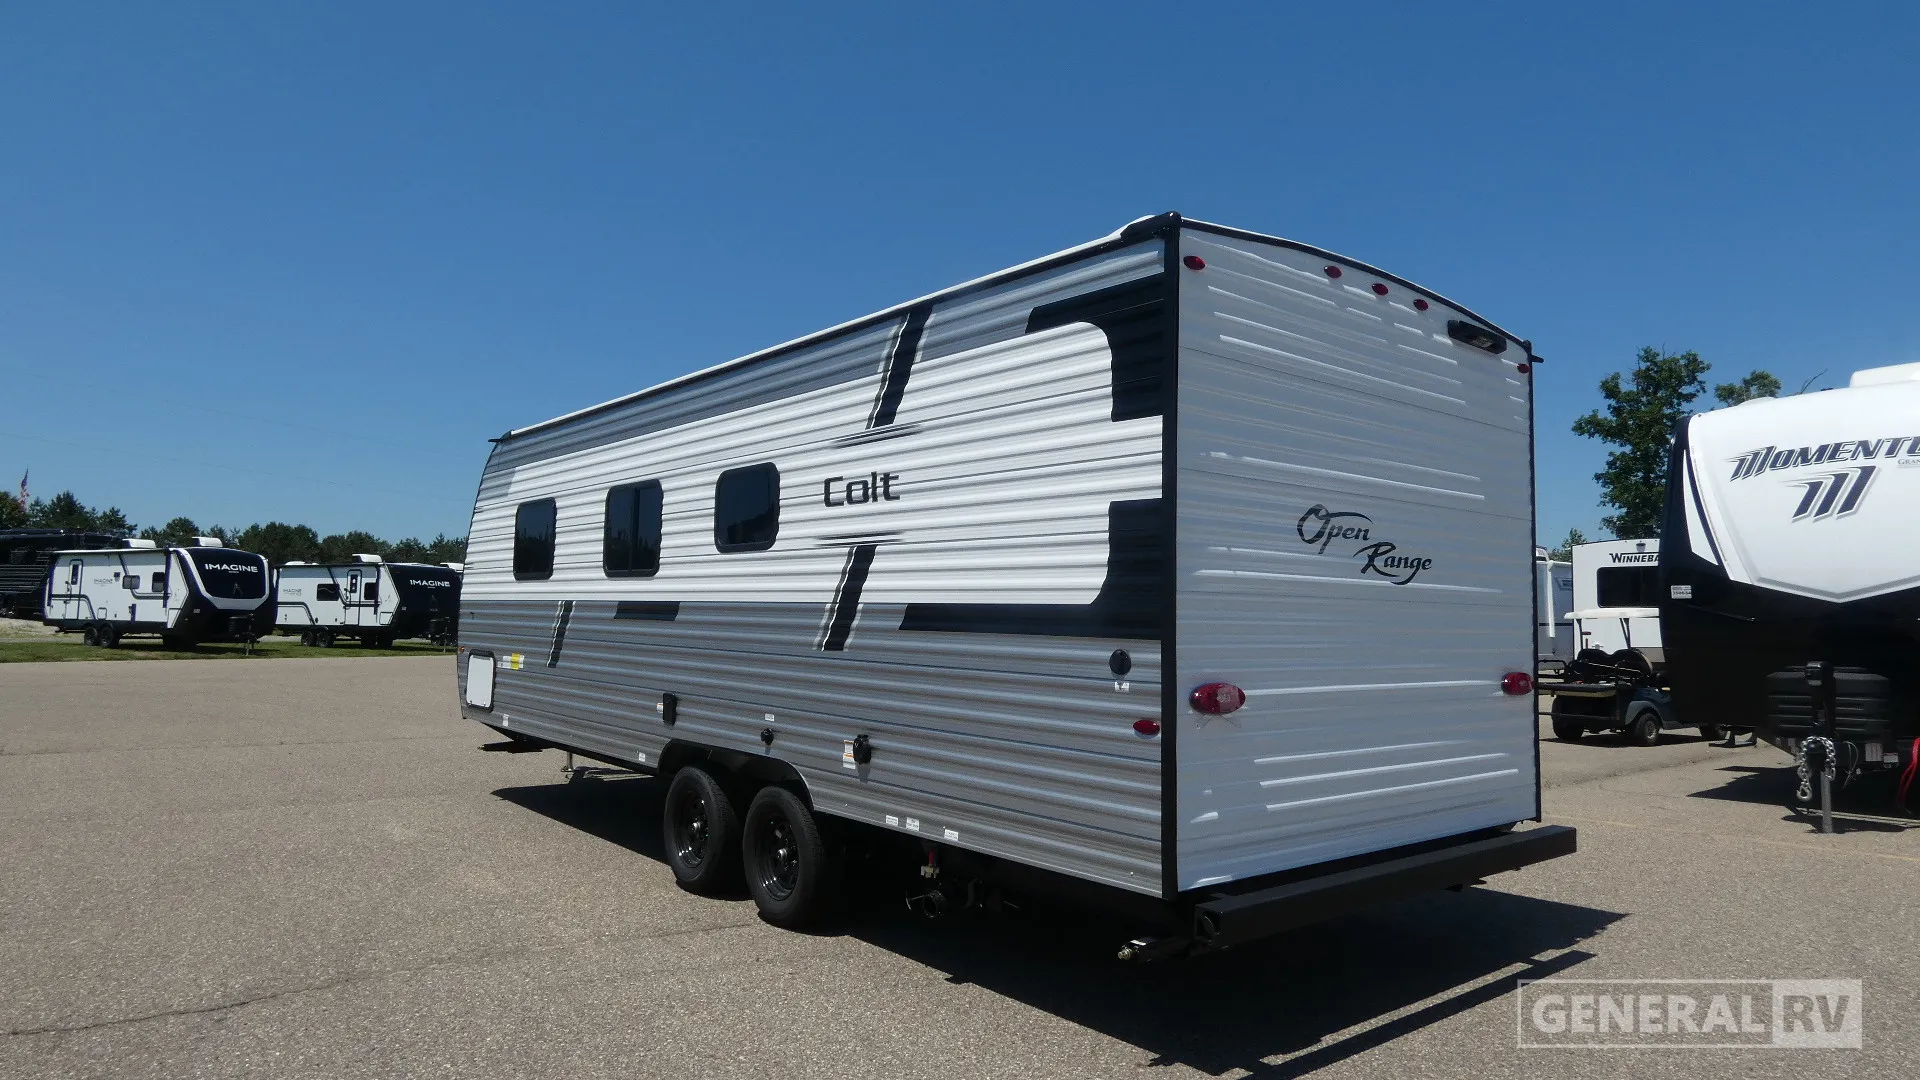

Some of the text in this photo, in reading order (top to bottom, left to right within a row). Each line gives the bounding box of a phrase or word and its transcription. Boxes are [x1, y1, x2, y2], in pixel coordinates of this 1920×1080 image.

[824, 471, 900, 507] Colt
[1297, 504, 1373, 554] Open
[205, 563, 258, 573] IMAGINE
[1352, 541, 1432, 585] Range
[409, 579, 451, 587] IMAGINE
